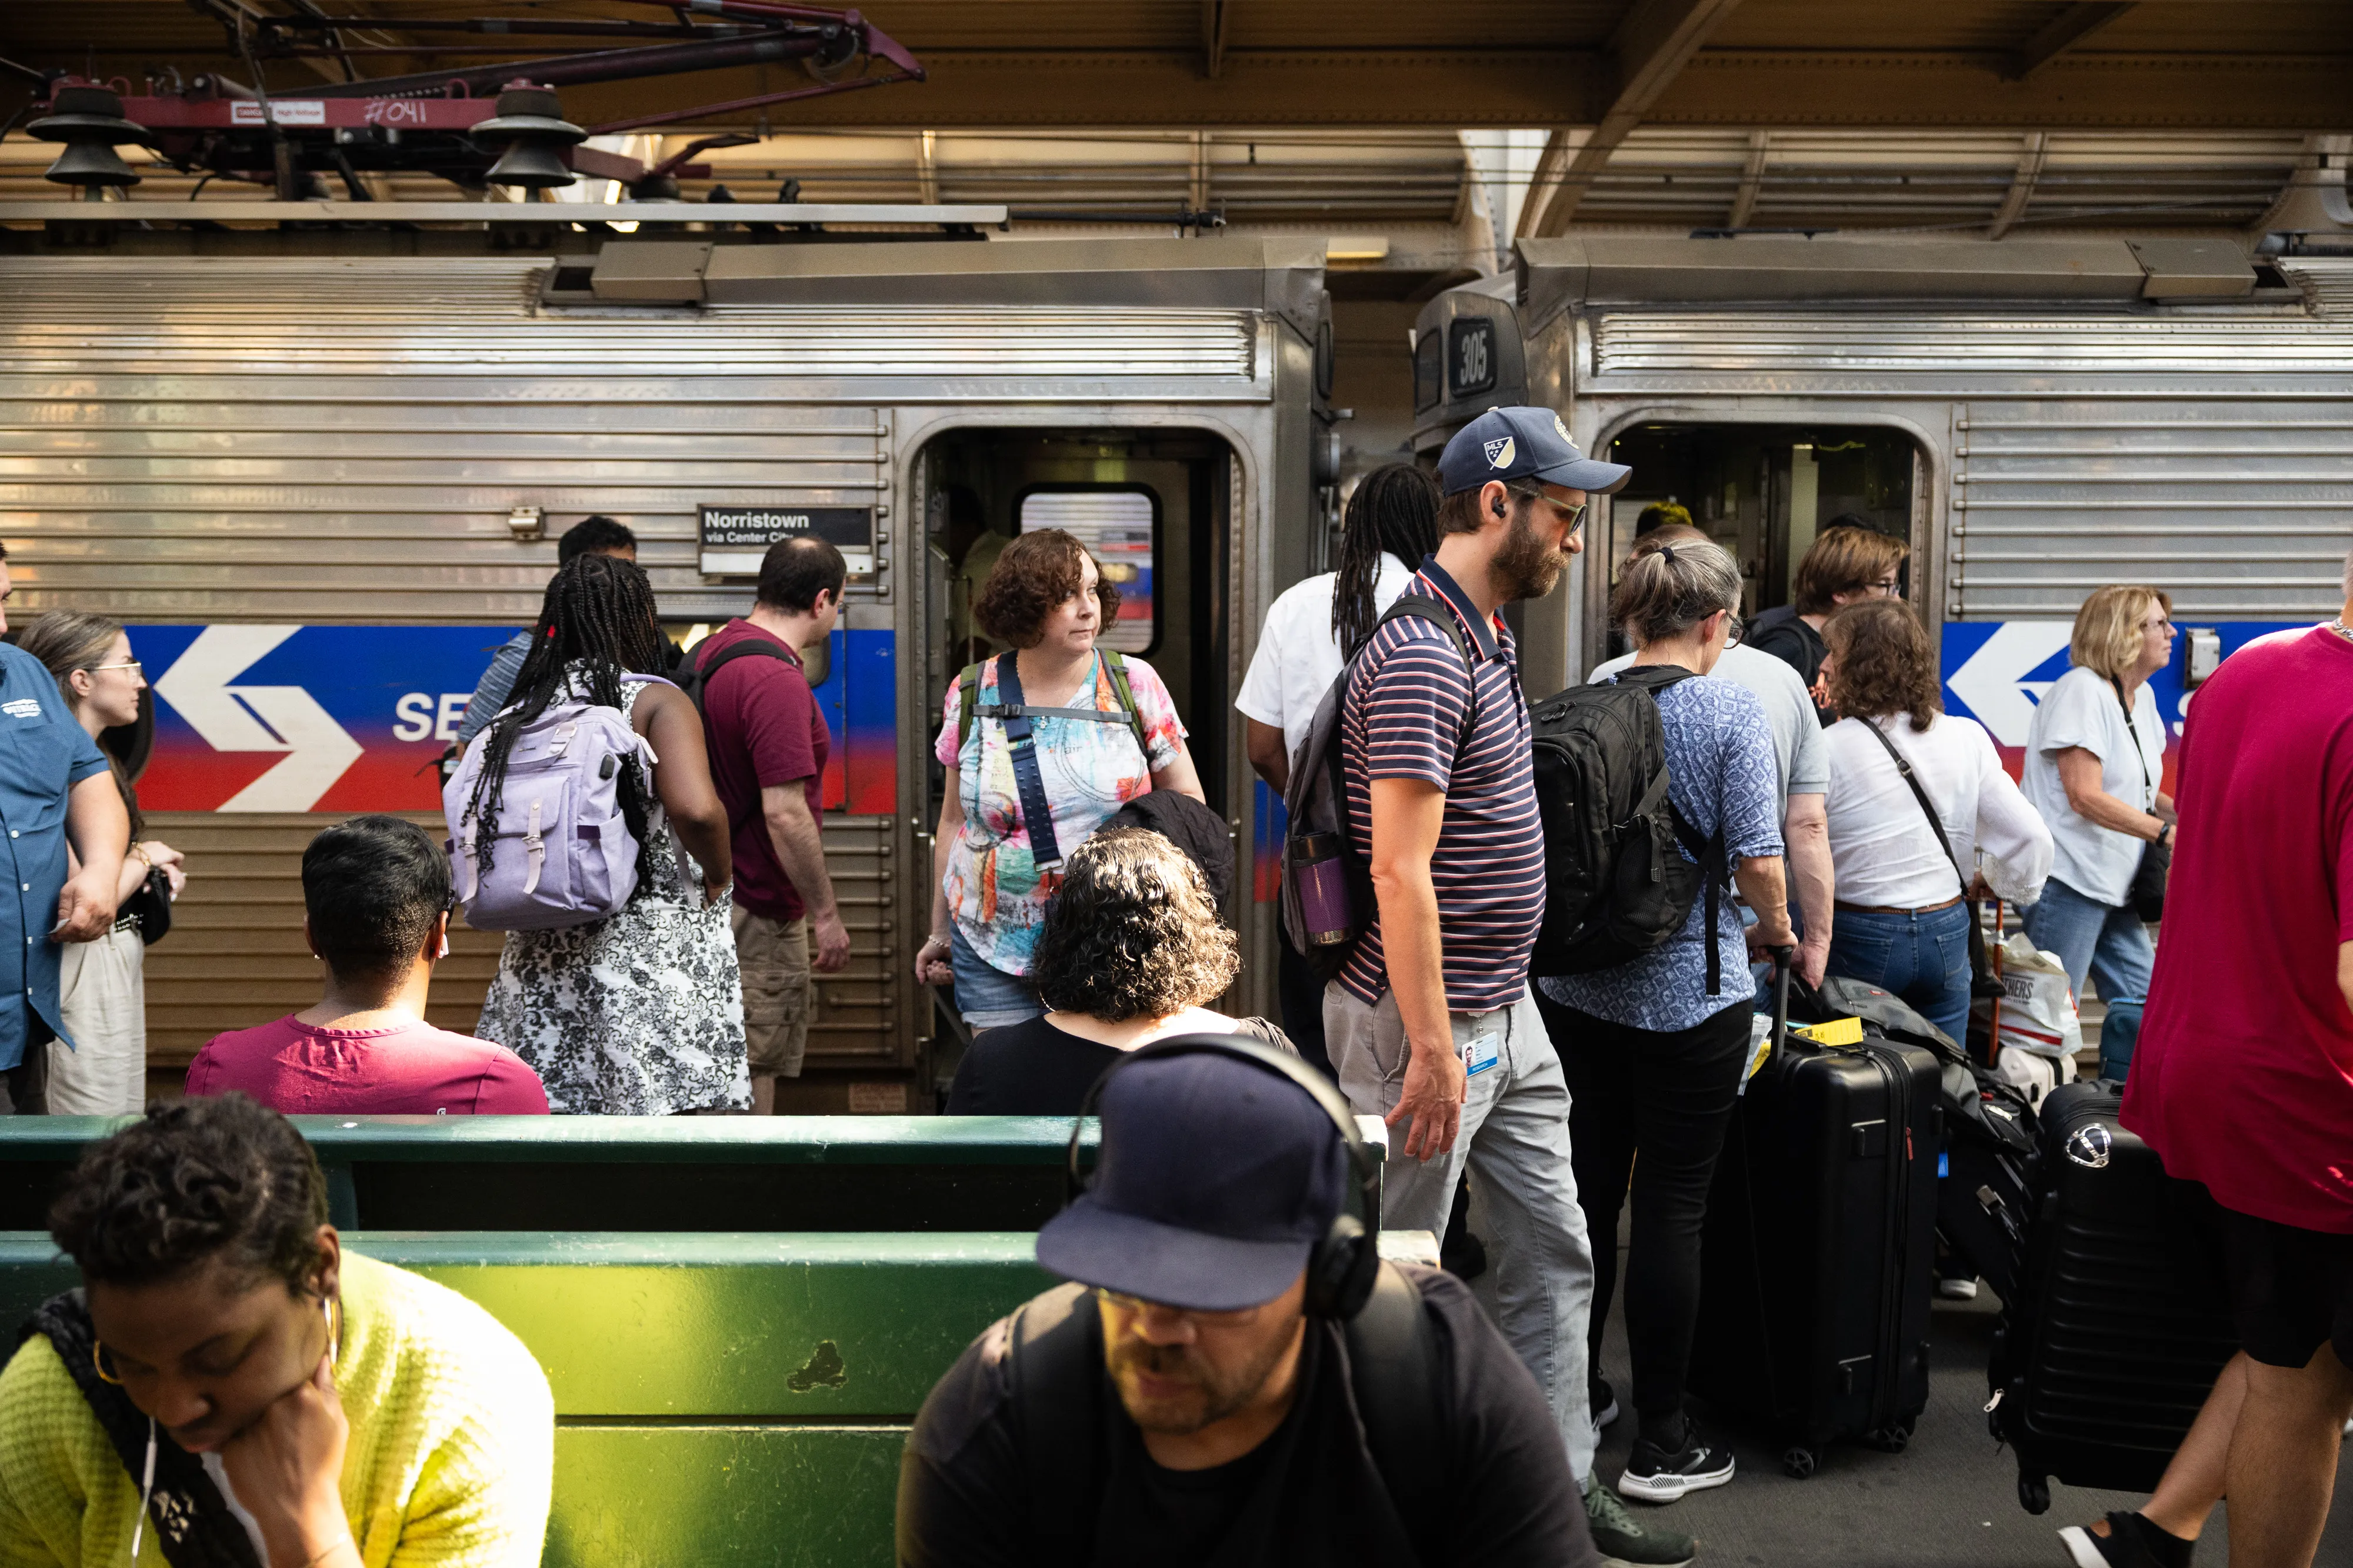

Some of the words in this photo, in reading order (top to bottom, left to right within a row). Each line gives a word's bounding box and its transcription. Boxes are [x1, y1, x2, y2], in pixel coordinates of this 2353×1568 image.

[364, 101, 426, 124] #041
[1460, 329, 1487, 386] 305
[1487, 441, 1504, 451] MLS
[705, 511, 809, 528] Norristown
[706, 532, 724, 543] via
[726, 532, 766, 543] Center
